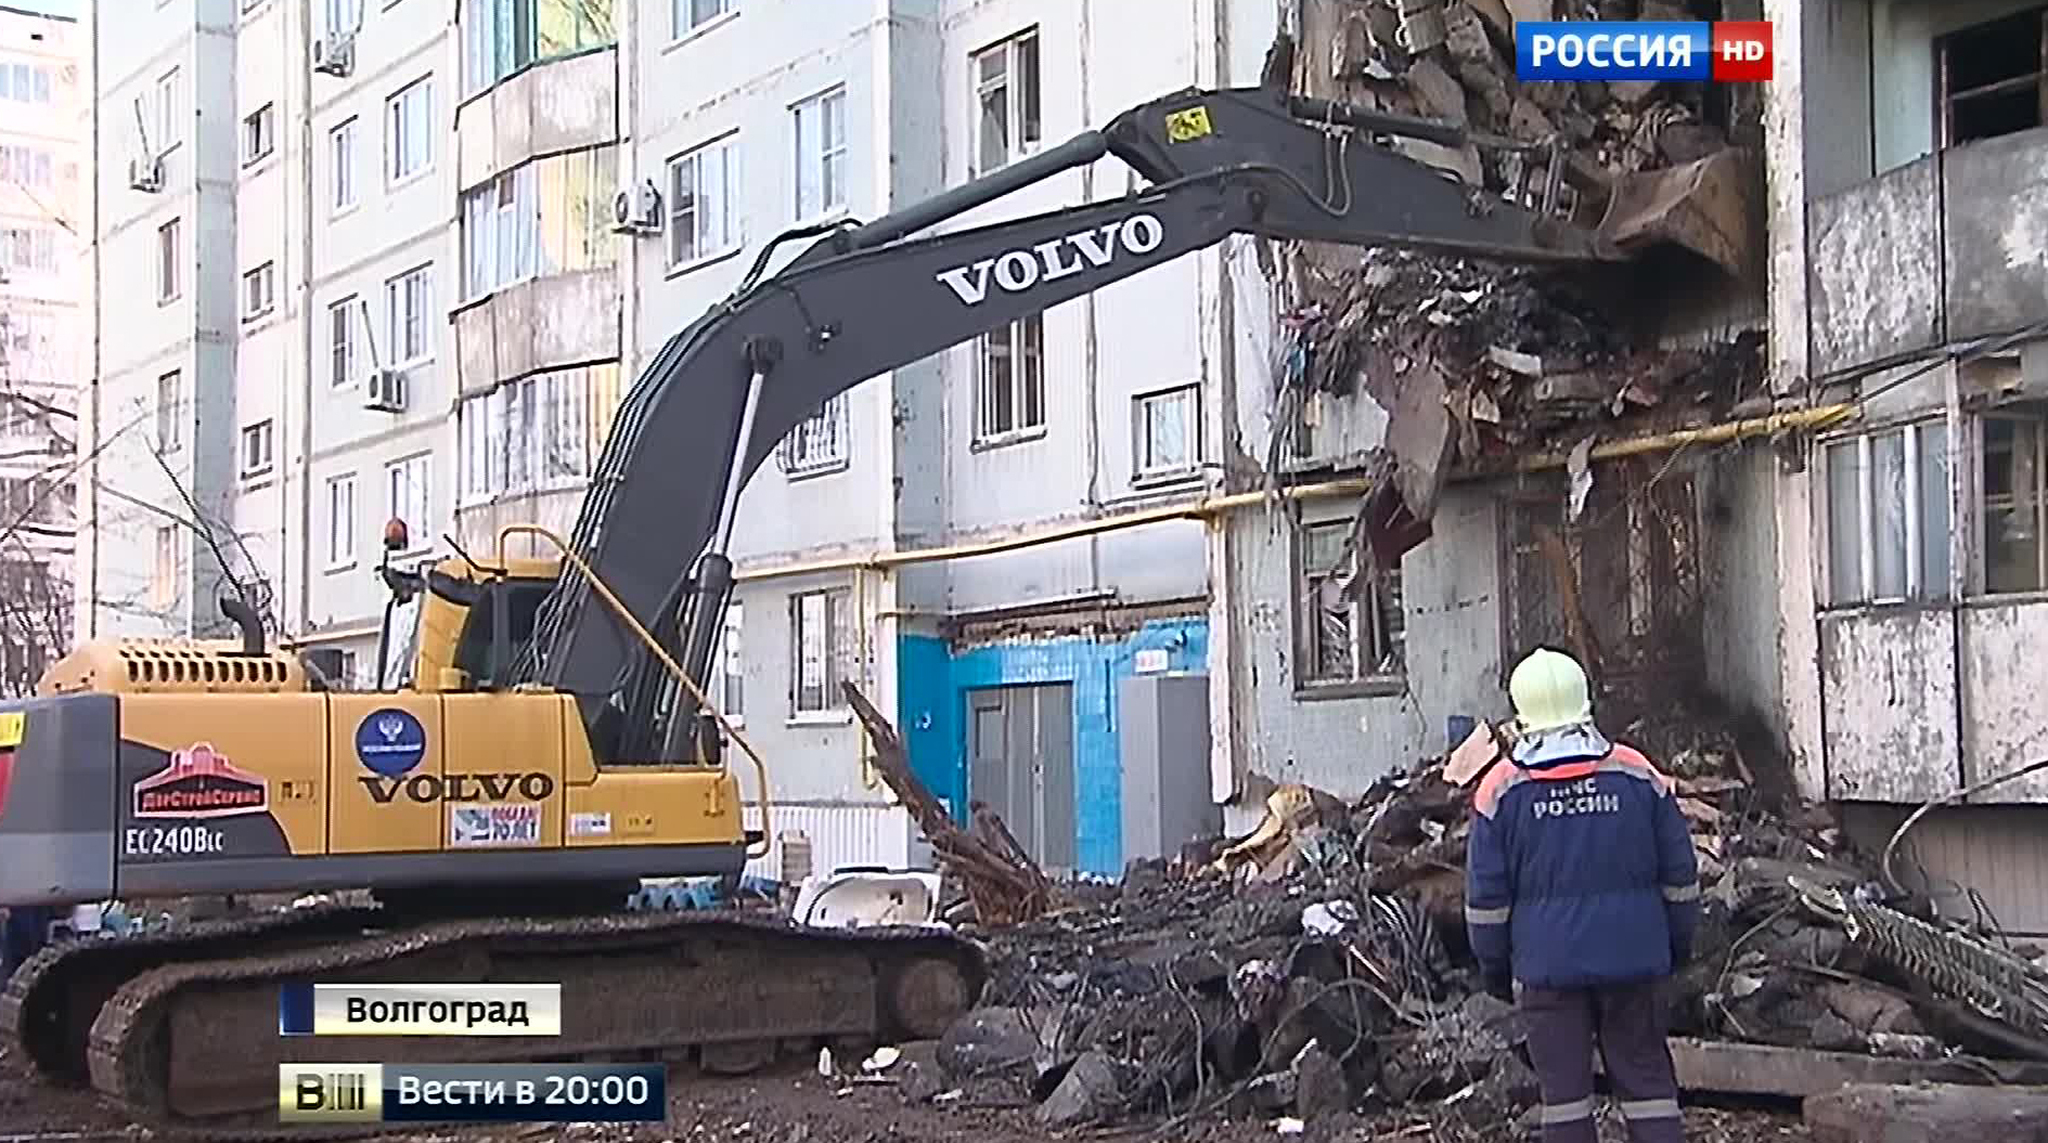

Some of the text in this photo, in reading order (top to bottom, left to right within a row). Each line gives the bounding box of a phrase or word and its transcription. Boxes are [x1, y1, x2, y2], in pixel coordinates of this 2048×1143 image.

[937, 214, 1163, 304] VOLVO
[358, 772, 554, 803] VOLVO
[1534, 793, 1619, 819] РОССИИ
